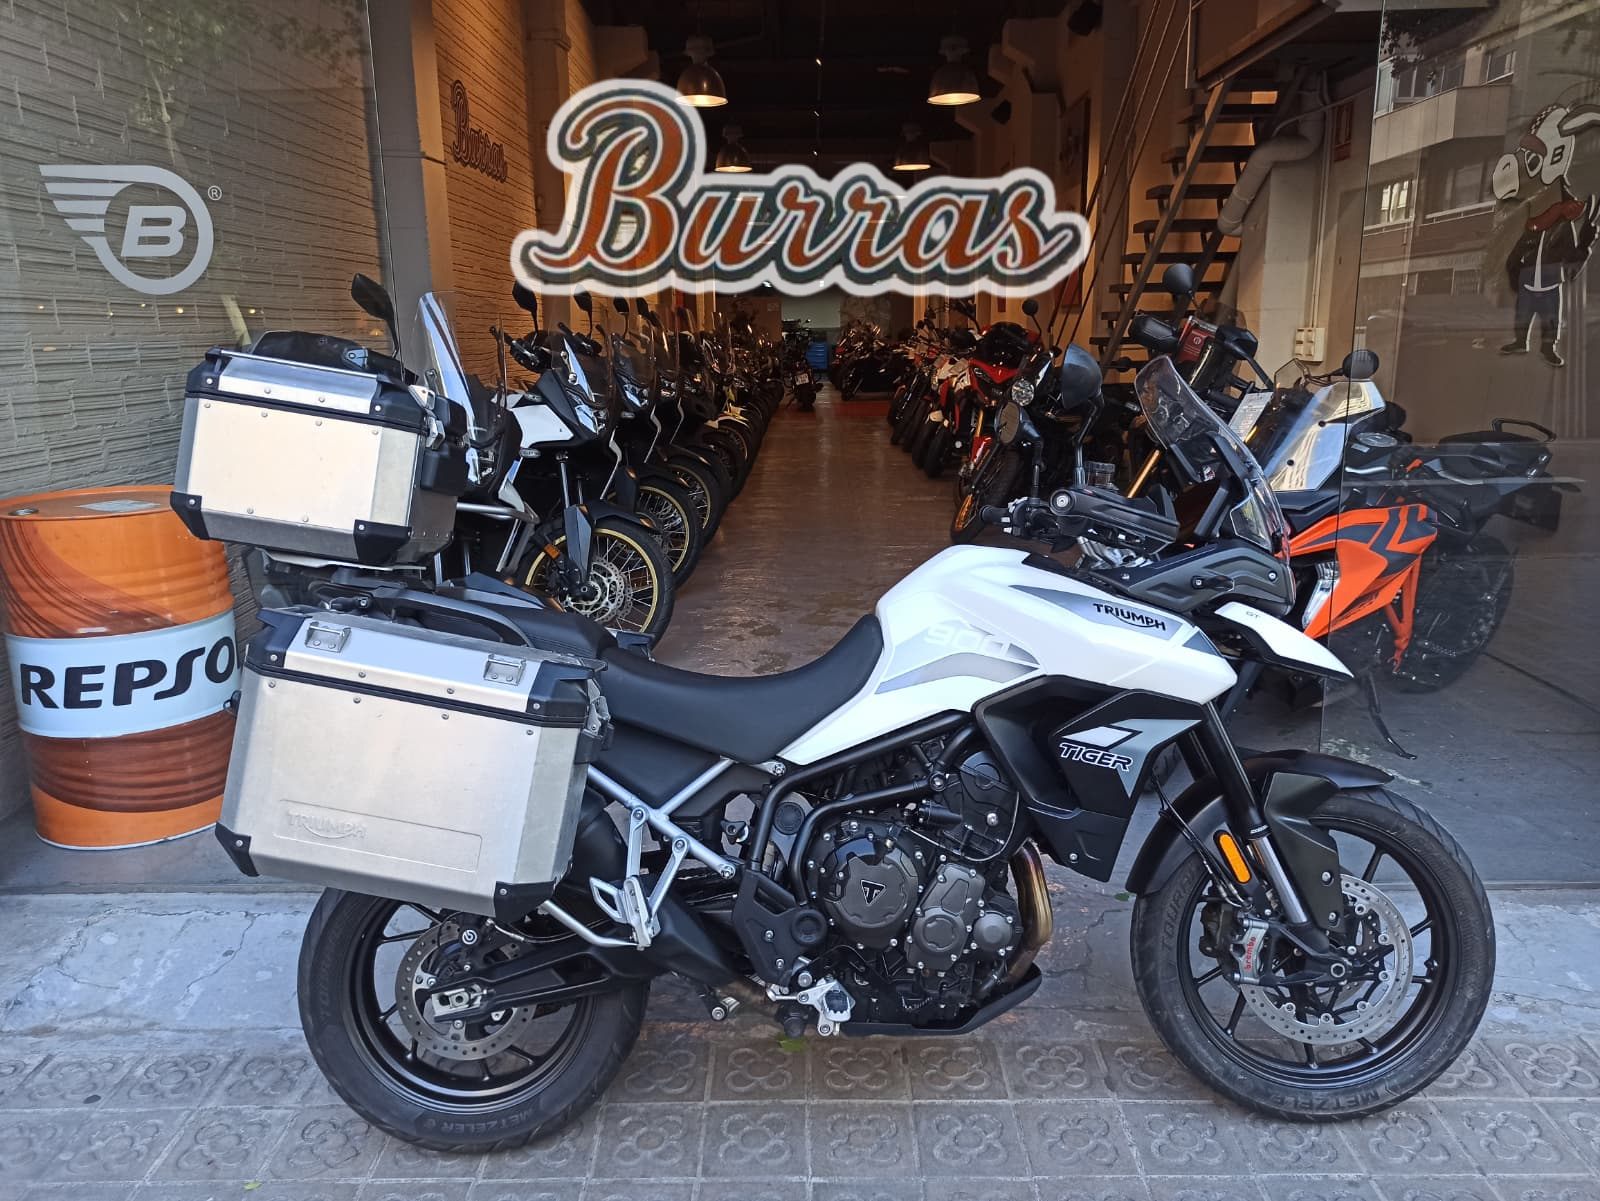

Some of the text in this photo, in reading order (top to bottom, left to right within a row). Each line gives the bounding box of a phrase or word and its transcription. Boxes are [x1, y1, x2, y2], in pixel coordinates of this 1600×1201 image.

[449, 80, 508, 183] Burras
[1093, 602, 1167, 632] TRIUMPH
[19, 631, 241, 710] REPSO
[1059, 742, 1134, 772] TIGER
[287, 809, 369, 840] TRIUMPH
[1243, 936, 1257, 972] brembo
